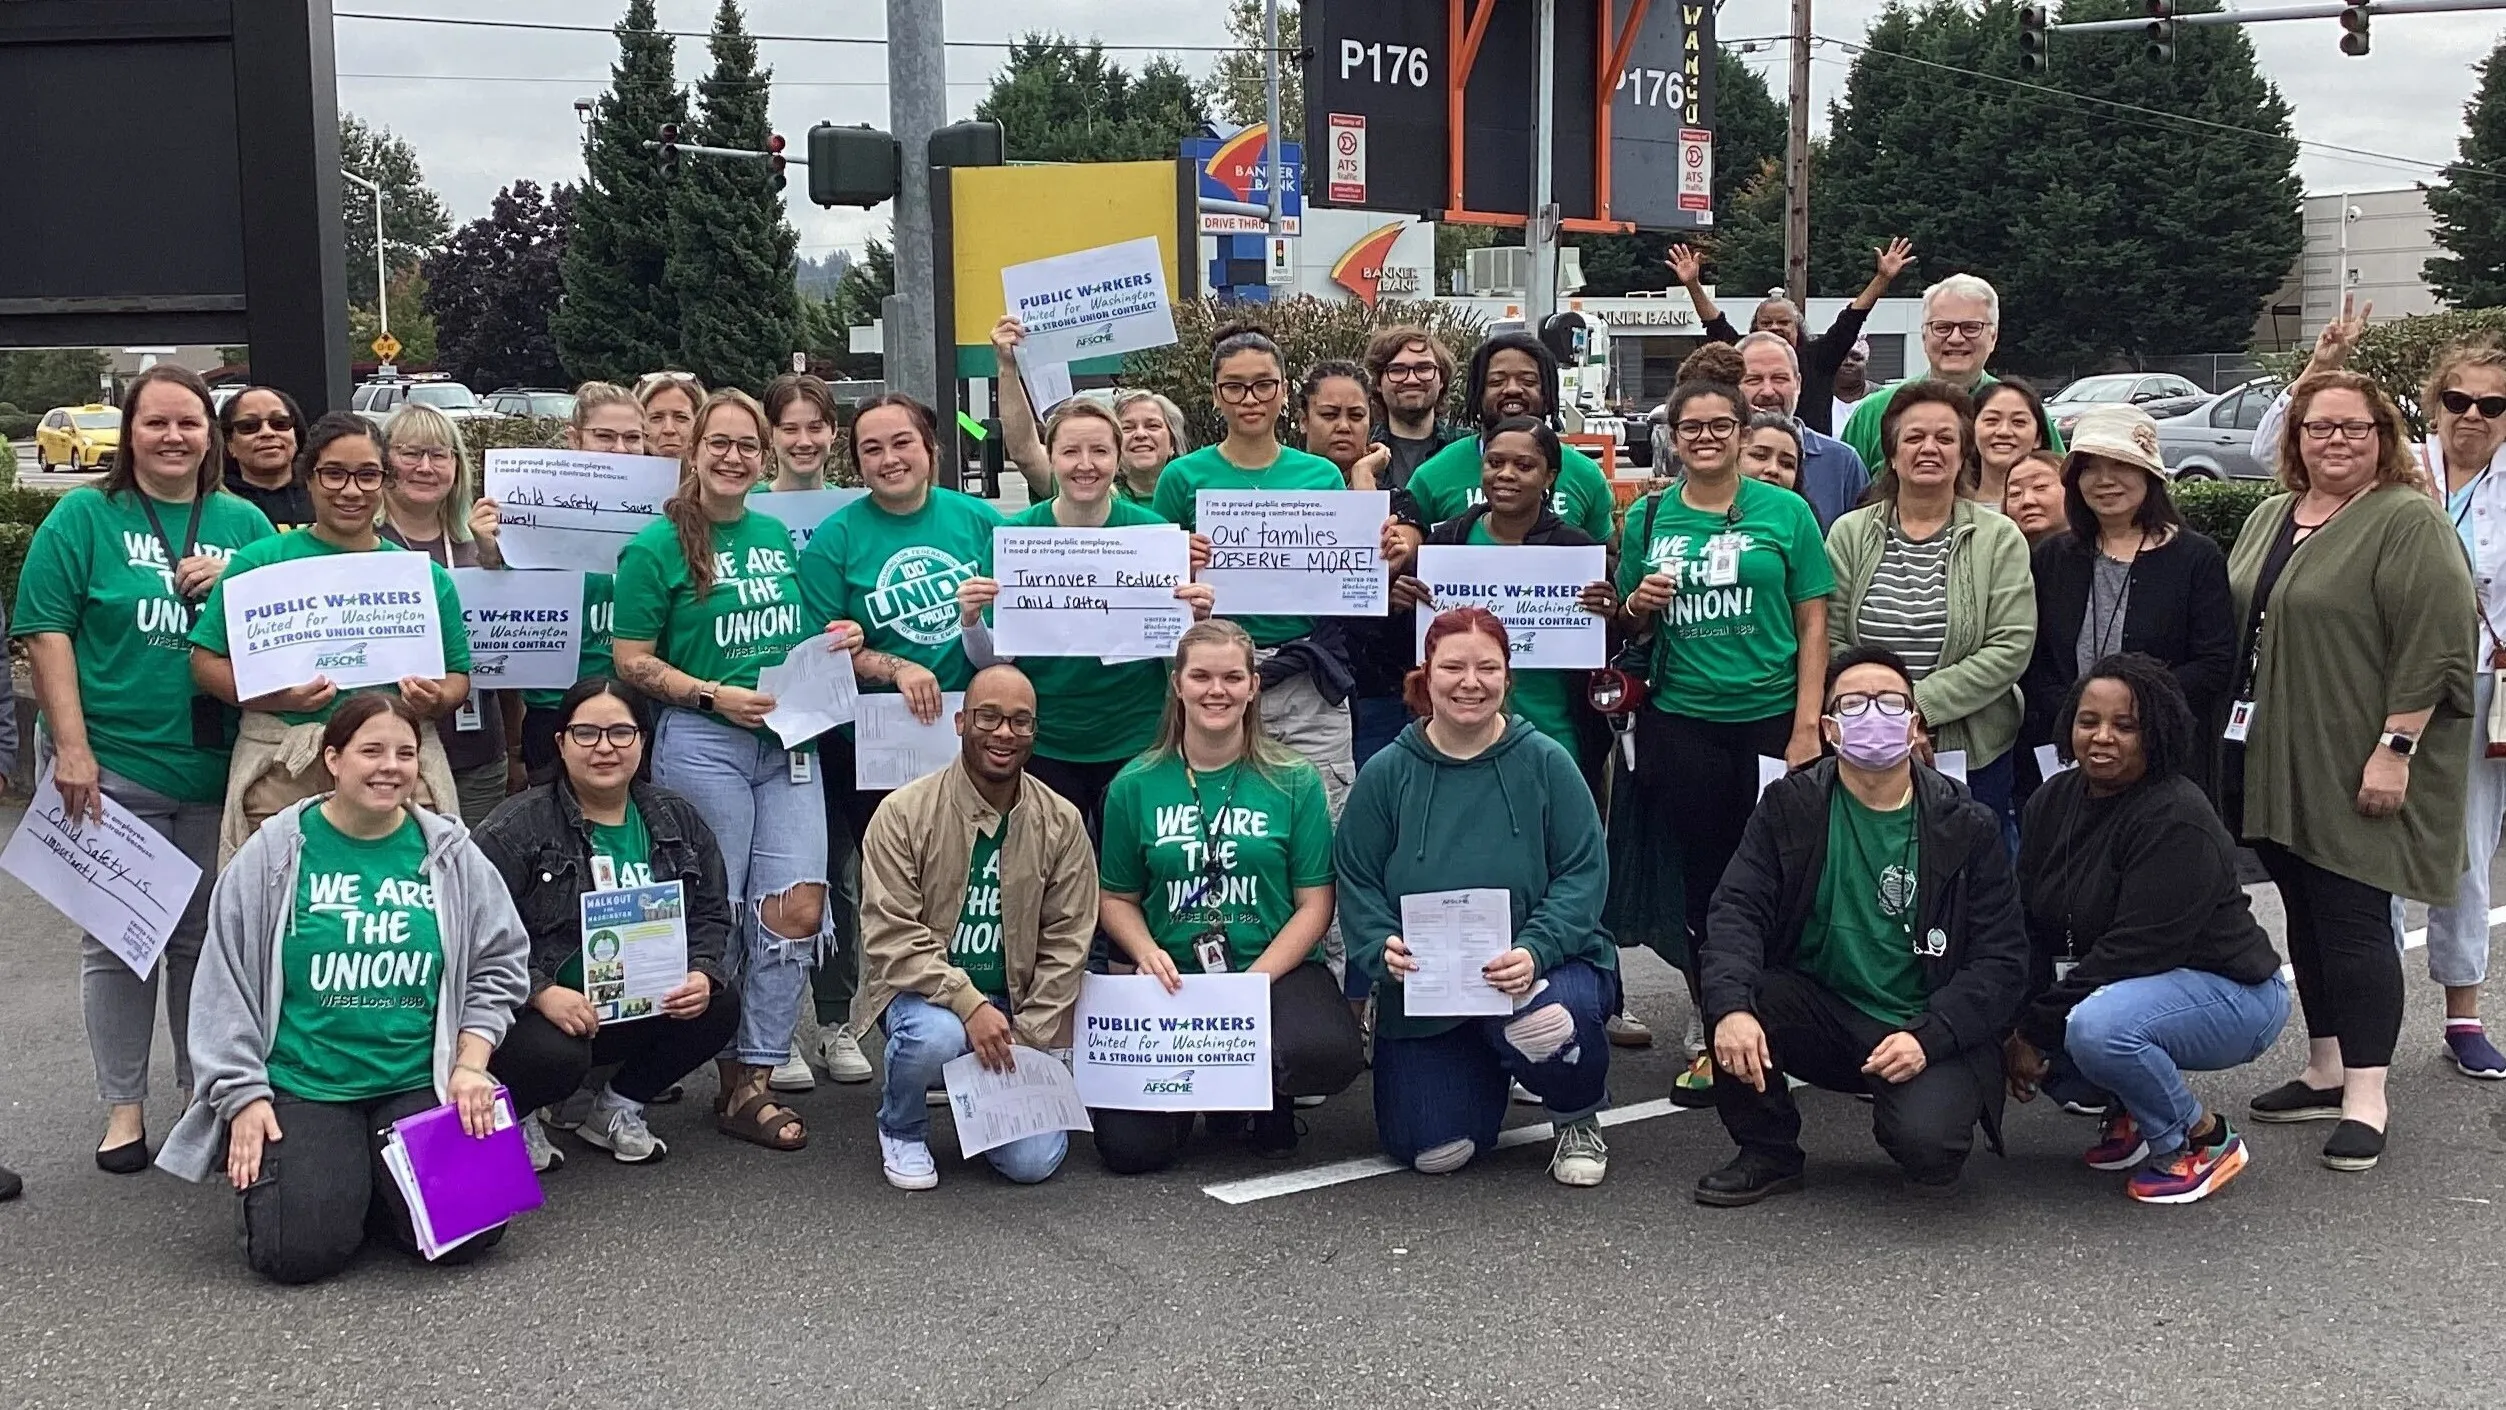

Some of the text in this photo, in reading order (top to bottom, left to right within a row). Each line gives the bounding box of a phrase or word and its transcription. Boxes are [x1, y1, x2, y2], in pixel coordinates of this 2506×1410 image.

[1340, 38, 1429, 87] P176
[1337, 160, 1358, 172] ATS
[1686, 172, 1703, 182] ATS
[1204, 218, 1296, 230] DRIVE THRU TM
[1020, 288, 1072, 310] PUBLIC
[1022, 290, 1156, 324] United for Washington
[1043, 317, 1077, 330] STRONG
[1080, 312, 1110, 323] UNION
[1112, 300, 1158, 316] CONTRACT
[1648, 311, 1694, 326] BANK
[1076, 333, 1114, 348] AFSCME
[518, 459, 544, 468] proud
[546, 459, 570, 468] public
[531, 468, 557, 476] strong
[559, 470, 591, 478] contract
[1229, 500, 1252, 509] proud
[1255, 500, 1278, 509] public
[1241, 510, 1266, 518] strong
[1212, 520, 1338, 548] Our families
[124, 530, 168, 563] WE
[1028, 538, 1052, 547] proud
[1054, 538, 1078, 547] public
[1650, 535, 1692, 560] WE
[1040, 548, 1066, 556] strong
[1102, 547, 1138, 556] because:
[746, 547, 792, 573] ARE
[1212, 547, 1373, 575] DESERVE MORE!
[1116, 571, 1180, 587] Reduces
[1676, 560, 1709, 588] TH
[736, 576, 784, 606] THE
[1434, 584, 1498, 597] PUBLIC
[244, 596, 318, 622] PUBLIC
[1017, 595, 1054, 608] Child
[1486, 600, 1586, 616] for Washingto
[247, 606, 425, 638] United for Washington
[918, 604, 956, 628] PROUD
[1538, 617, 1592, 626] CONTRACT
[490, 624, 568, 640] Washington
[716, 604, 801, 648] UNION!
[249, 624, 426, 651] & A STRONG UNION CONTRACT
[474, 640, 566, 650] UNION CONTRACT
[1510, 643, 1534, 652] CME
[314, 654, 367, 668] AFSCME
[472, 665, 505, 674] SCME
[48, 806, 83, 843] Child
[1156, 803, 1269, 838] WE ARE
[1181, 840, 1238, 872] THE
[620, 861, 654, 888] AR
[310, 872, 435, 910] WE ARE
[586, 894, 632, 909] WALKOUT
[968, 884, 1000, 916] HE
[340, 910, 411, 945] THE
[310, 951, 432, 992] UNION!
[320, 994, 359, 1008] WFSE
[1087, 1016, 1152, 1032] PUBLIC
[1088, 1032, 1256, 1053] United for Washington
[1088, 1052, 1256, 1063] & A STRONG UNION CONTRACT
[1143, 1082, 1193, 1093] AFSCME
